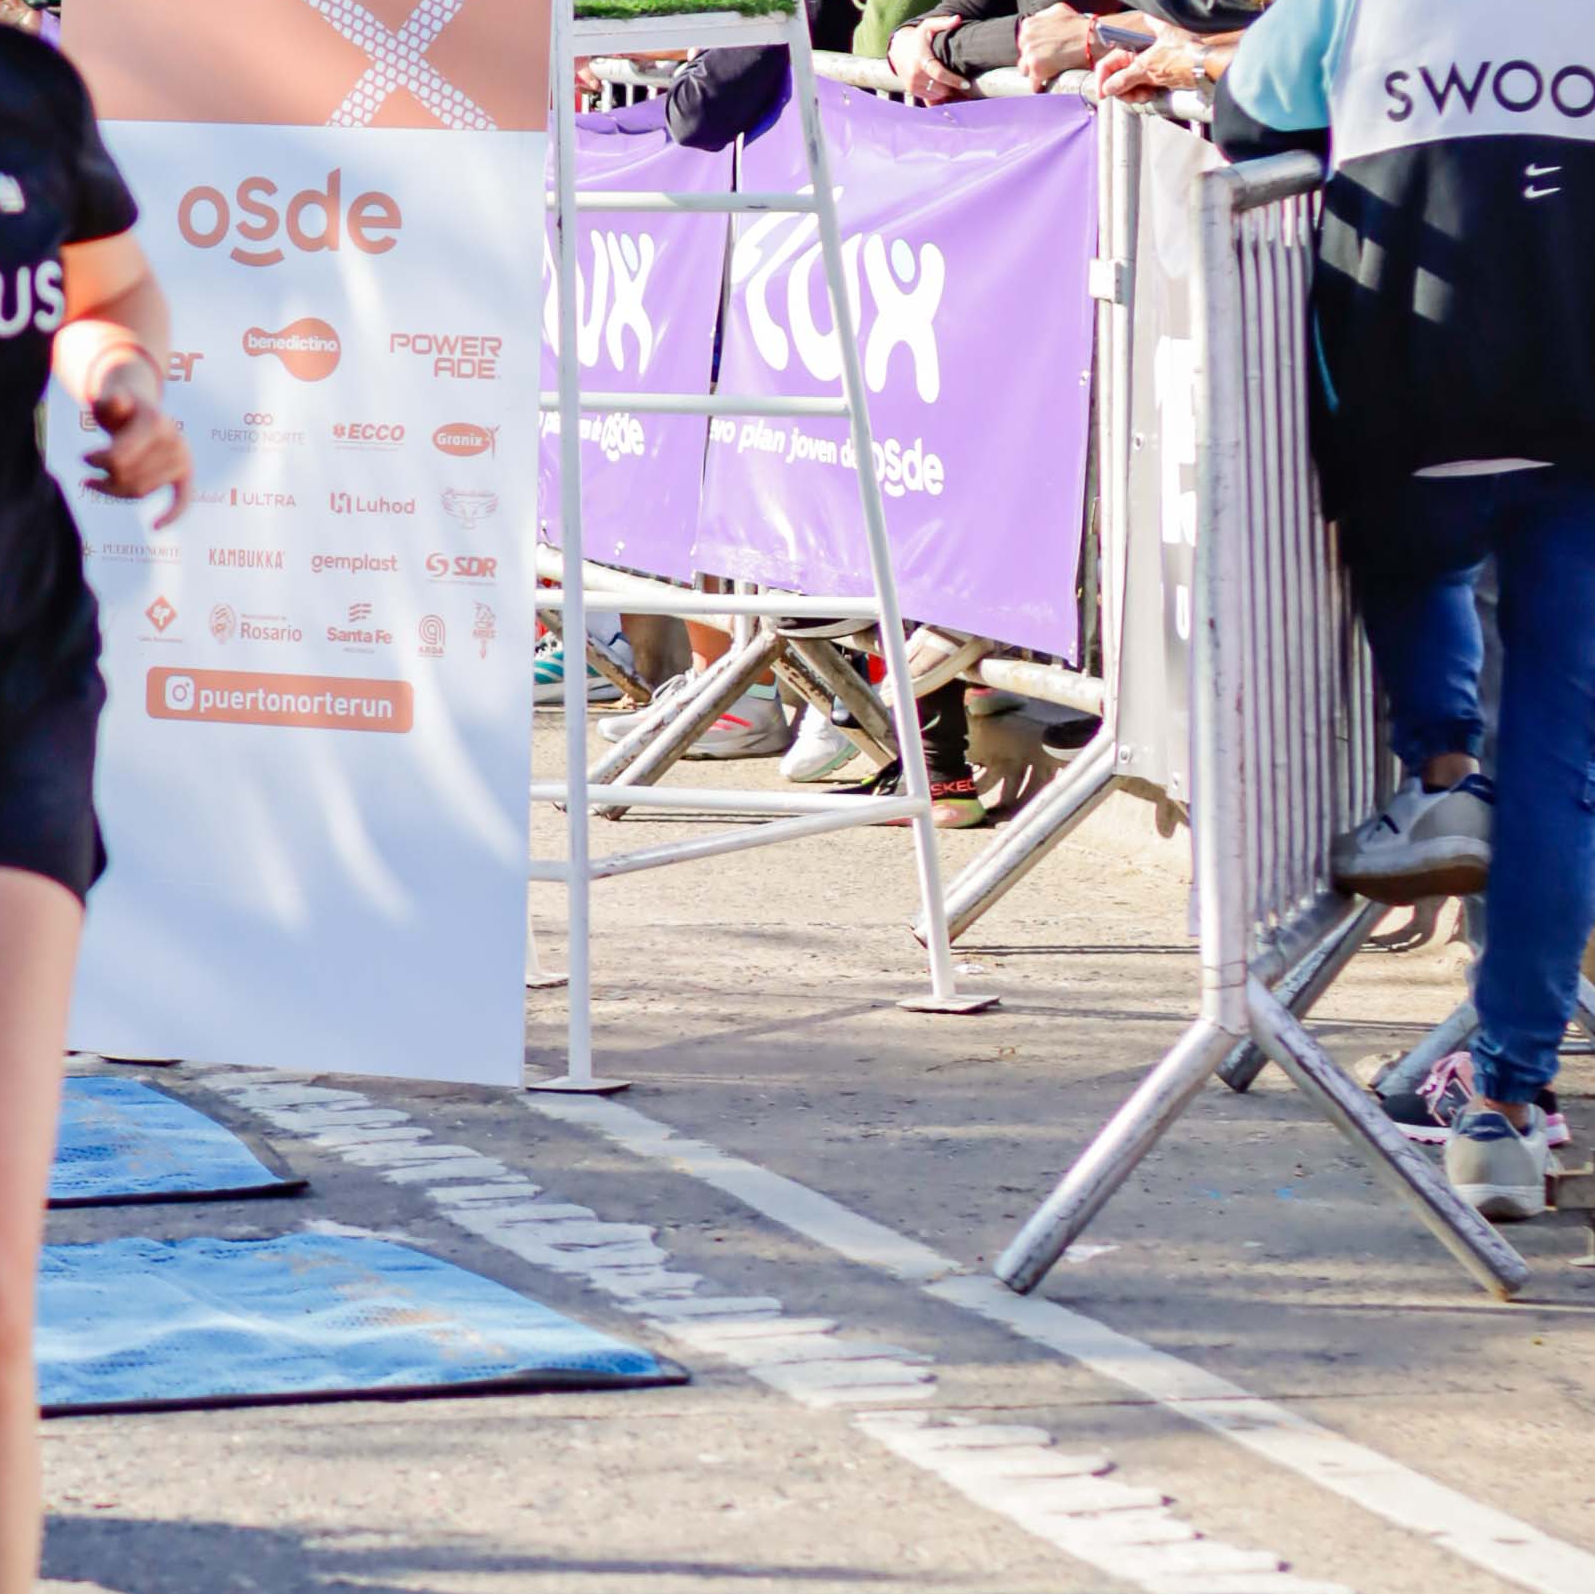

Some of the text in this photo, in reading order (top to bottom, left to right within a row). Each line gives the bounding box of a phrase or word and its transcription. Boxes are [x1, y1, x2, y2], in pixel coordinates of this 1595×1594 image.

[177, 167, 403, 266] osde
[247, 333, 339, 353] benedictino
[390, 333, 503, 358] POWER
[433, 359, 497, 379] ADE
[347, 423, 406, 441] ECCO
[737, 419, 786, 453] plan
[786, 427, 838, 464] joven
[242, 492, 296, 508] ULTRA
[355, 496, 416, 515] Luhod
[209, 548, 284, 569] KAMBUKKA
[310, 553, 399, 575] gemplast
[452, 556, 498, 578] SDR
[239, 622, 303, 643] Rosario
[326, 626, 393, 645] Santa Fe
[199, 686, 394, 719] puertonorterun
